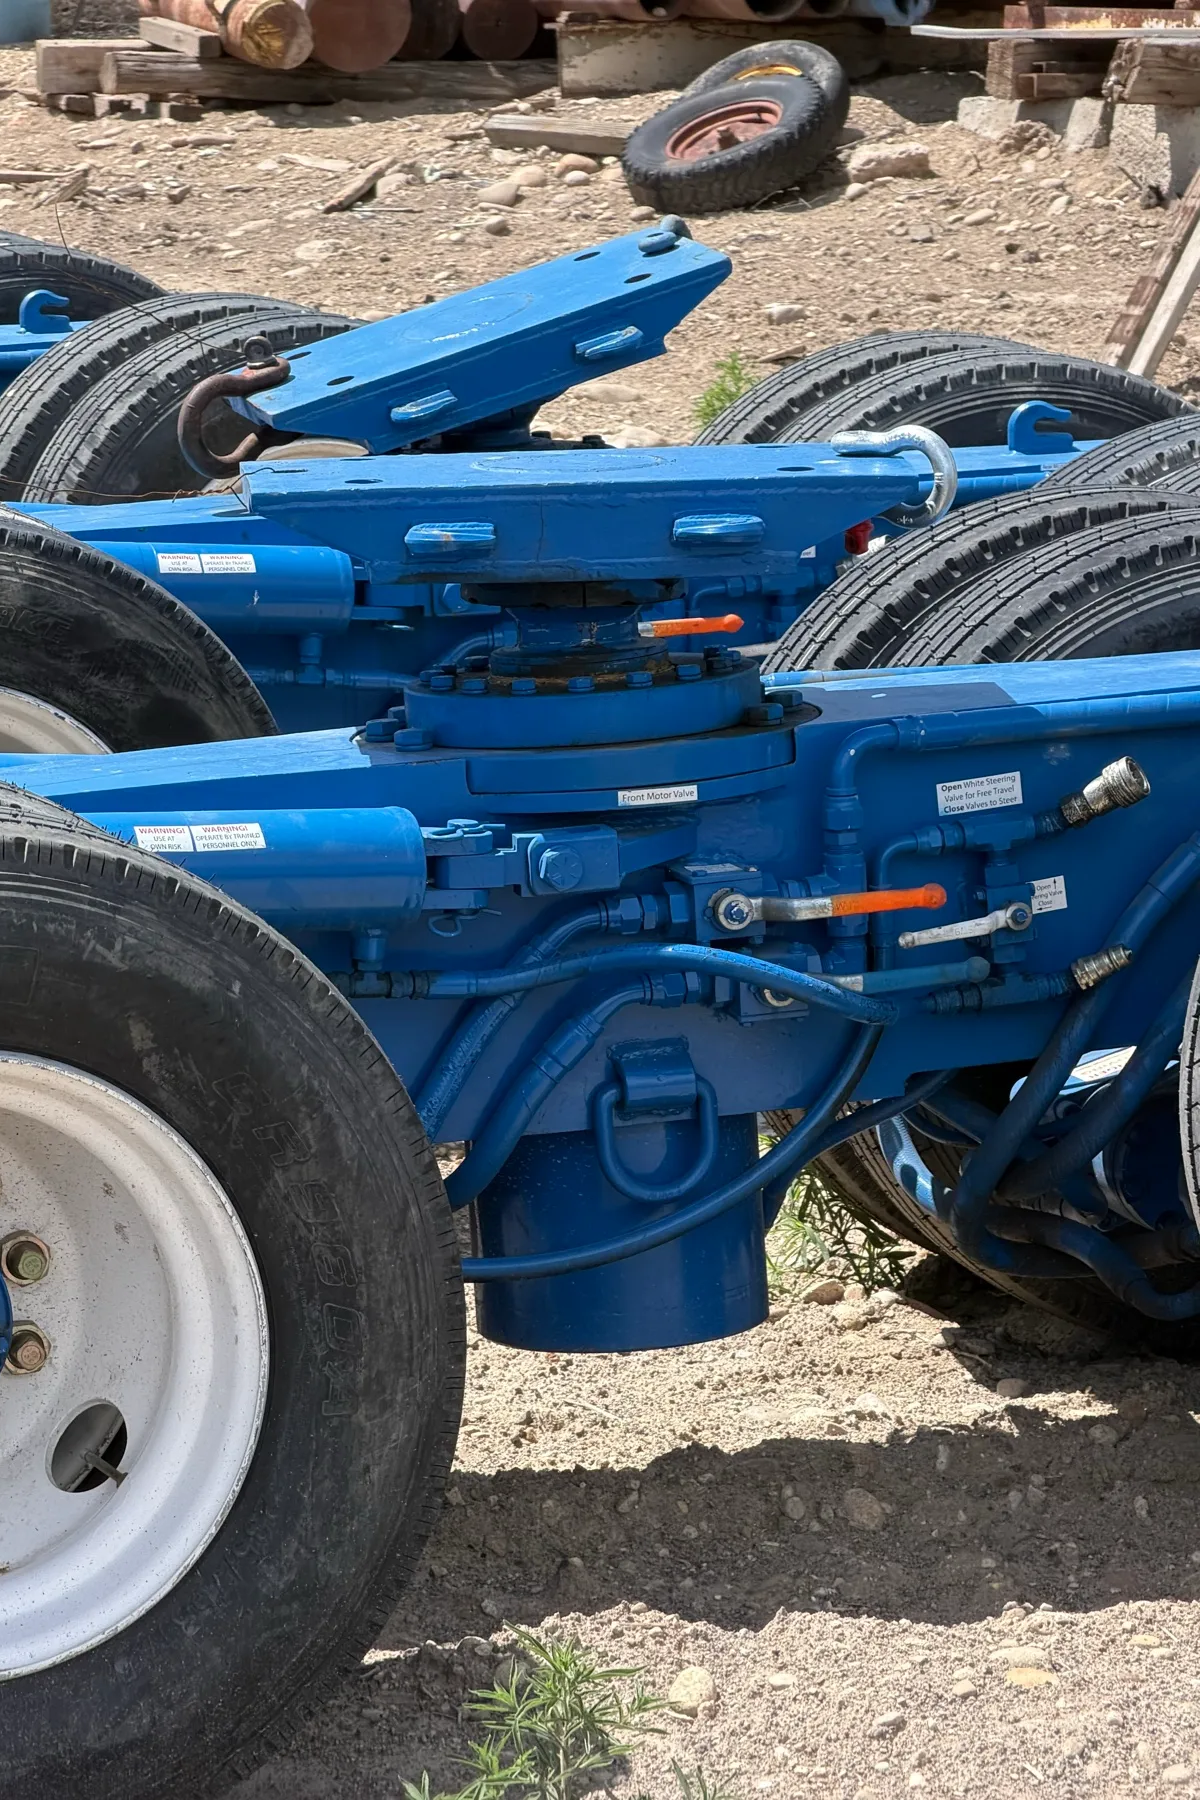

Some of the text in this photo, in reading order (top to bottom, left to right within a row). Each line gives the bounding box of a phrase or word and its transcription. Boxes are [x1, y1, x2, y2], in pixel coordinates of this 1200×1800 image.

[941, 775, 1016, 793] Open White Steering
[622, 789, 695, 802] Front Motor Valve
[944, 785, 1015, 803] Valve for Free Travel
[943, 805, 965, 814] Close
[965, 801, 988, 810] Valves
[998, 796, 1017, 805] Steer
[201, 825, 249, 833] WARNING!
[195, 832, 261, 842] OPERATE BY TRAINED
[202, 840, 258, 849] PERSONNEL ONLY
[1036, 884, 1052, 892] Open
